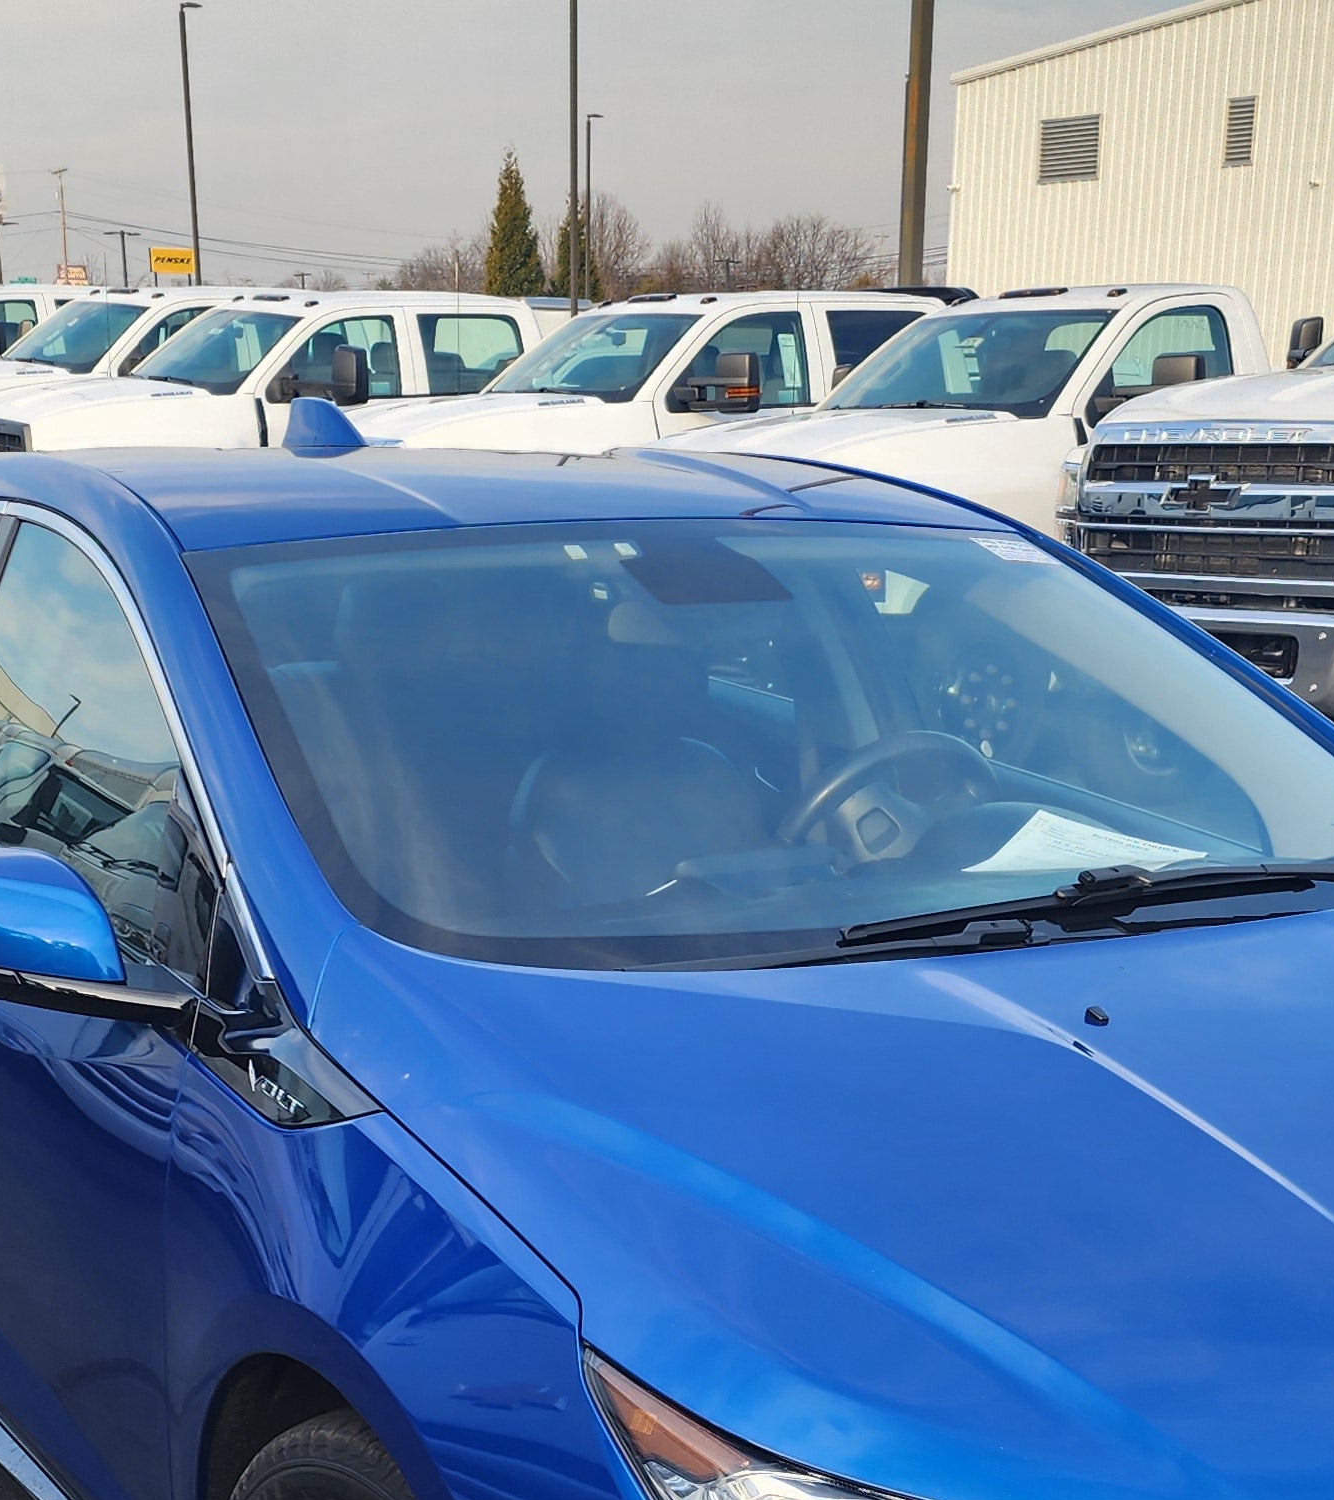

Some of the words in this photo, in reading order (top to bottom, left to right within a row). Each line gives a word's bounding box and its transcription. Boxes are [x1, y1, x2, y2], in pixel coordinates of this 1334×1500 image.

[154, 256, 192, 265] PENSKE
[1124, 427, 1315, 442] CHEVROLET
[248, 1058, 307, 1115] VOLT
